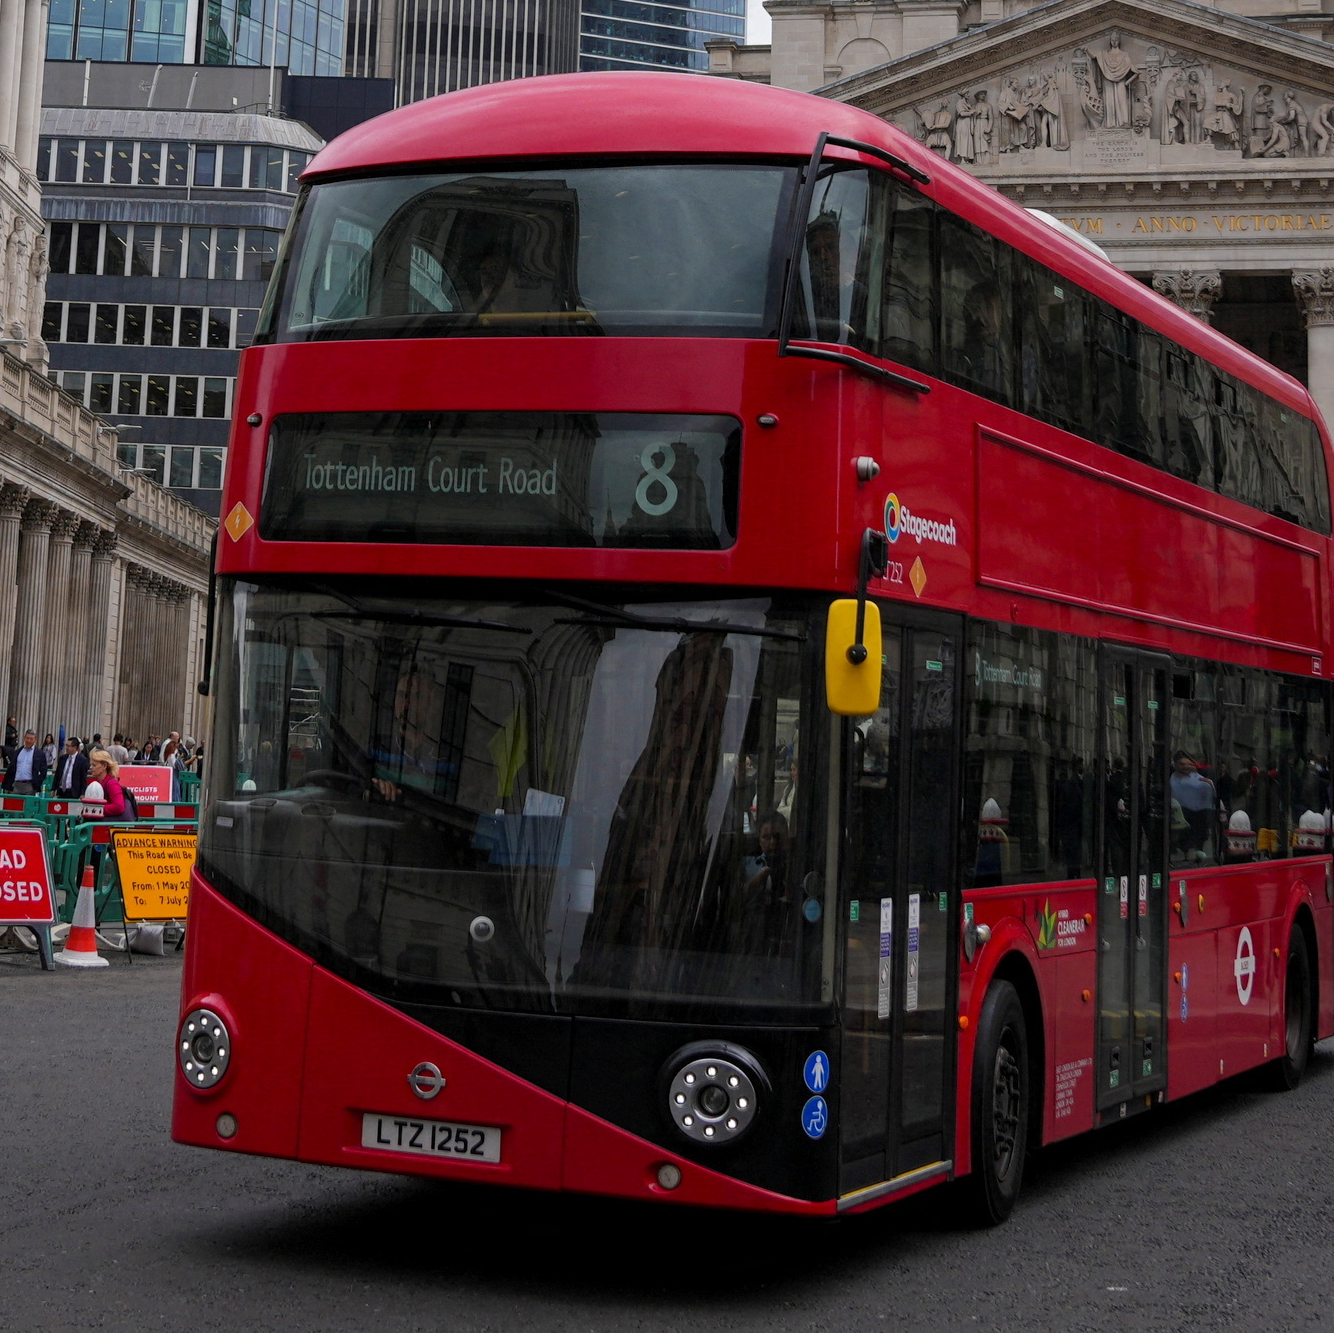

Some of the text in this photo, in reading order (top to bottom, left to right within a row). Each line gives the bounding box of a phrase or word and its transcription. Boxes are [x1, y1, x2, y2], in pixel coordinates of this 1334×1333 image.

[1132, 216, 1197, 233] ANNO
[1212, 213, 1333, 232] VICTORIAE
[304, 453, 557, 495] Tottenham Court Road
[635, 442, 679, 516] 8
[900, 504, 957, 546] Stagecoach
[883, 560, 904, 584] T252
[117, 838, 197, 848] ADVANCE WARNING
[128, 850, 193, 859] This Road will Be
[147, 865, 181, 874] CLOSED
[132, 881, 155, 890] From:
[162, 881, 178, 891] May
[134, 896, 147, 905] To:
[159, 895, 164, 905] 7
[167, 896, 182, 906] July
[376, 1118, 486, 1156] LTZ 1252
